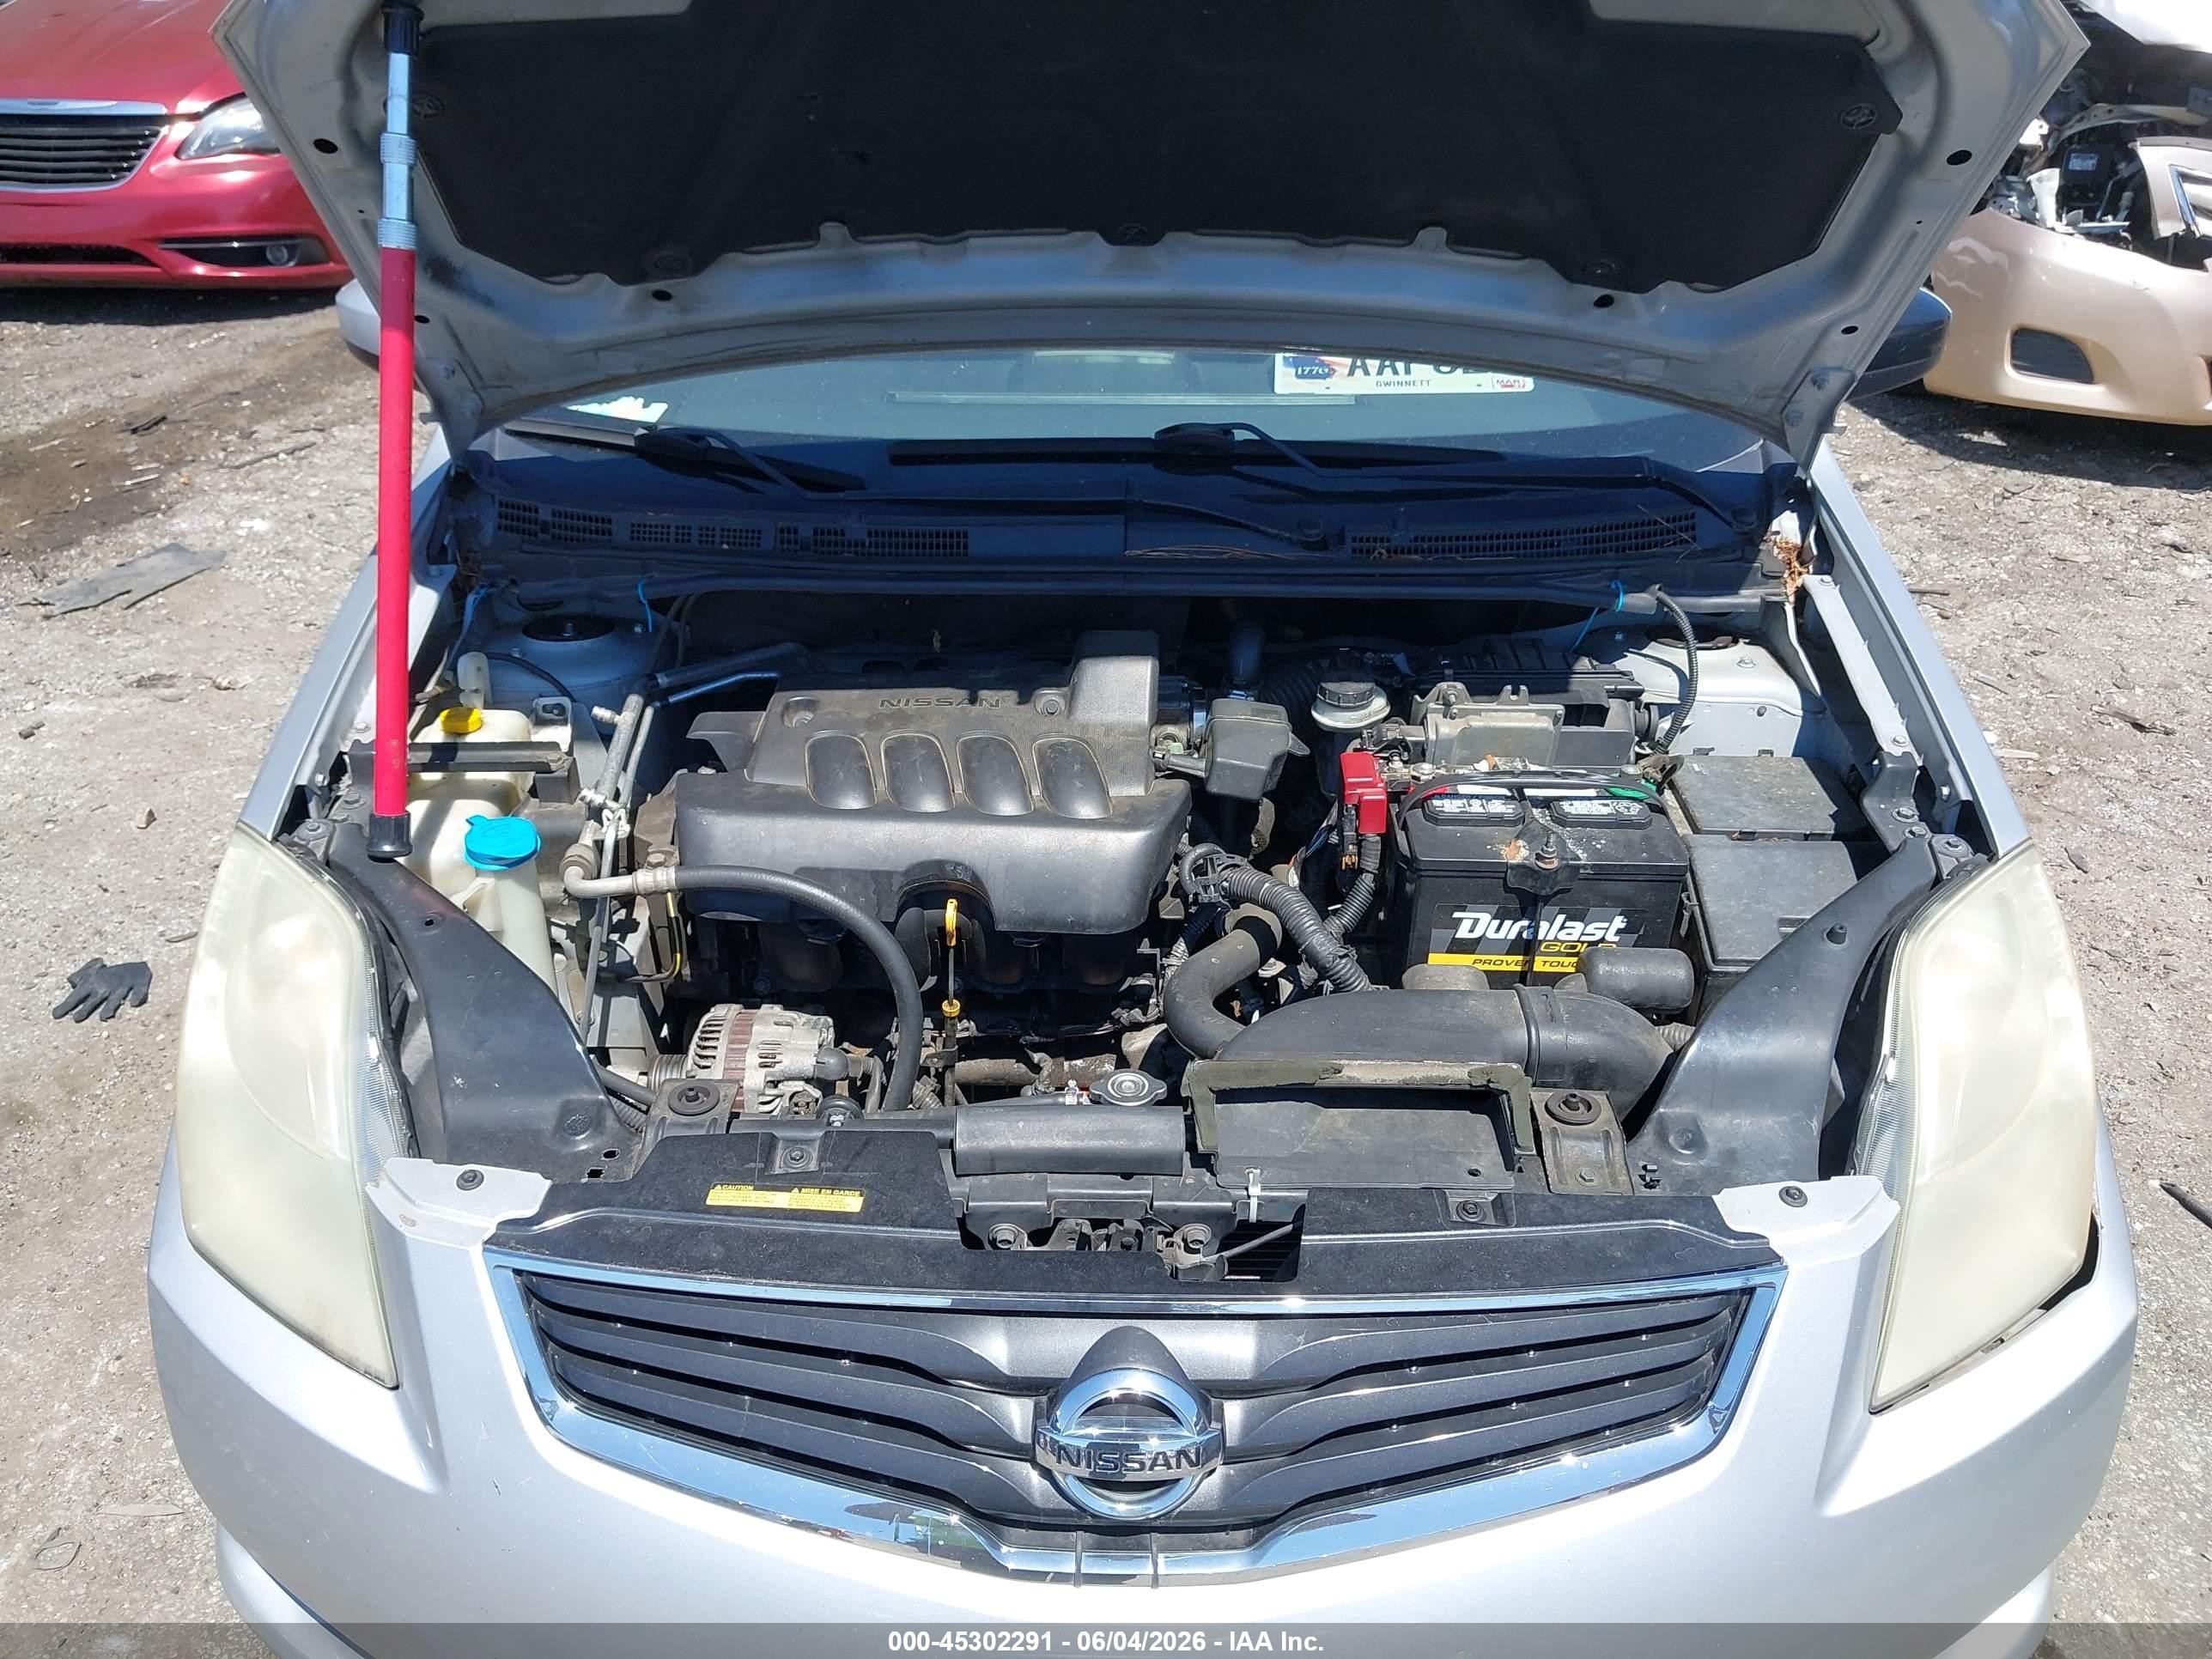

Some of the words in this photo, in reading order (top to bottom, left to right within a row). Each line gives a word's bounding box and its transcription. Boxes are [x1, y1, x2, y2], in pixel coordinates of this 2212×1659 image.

[1297, 367, 1328, 375] 1776
[880, 697, 1001, 708] NISSAN
[1452, 911, 1626, 942] Duralast
[1055, 1445, 1202, 1473] NISSAN
